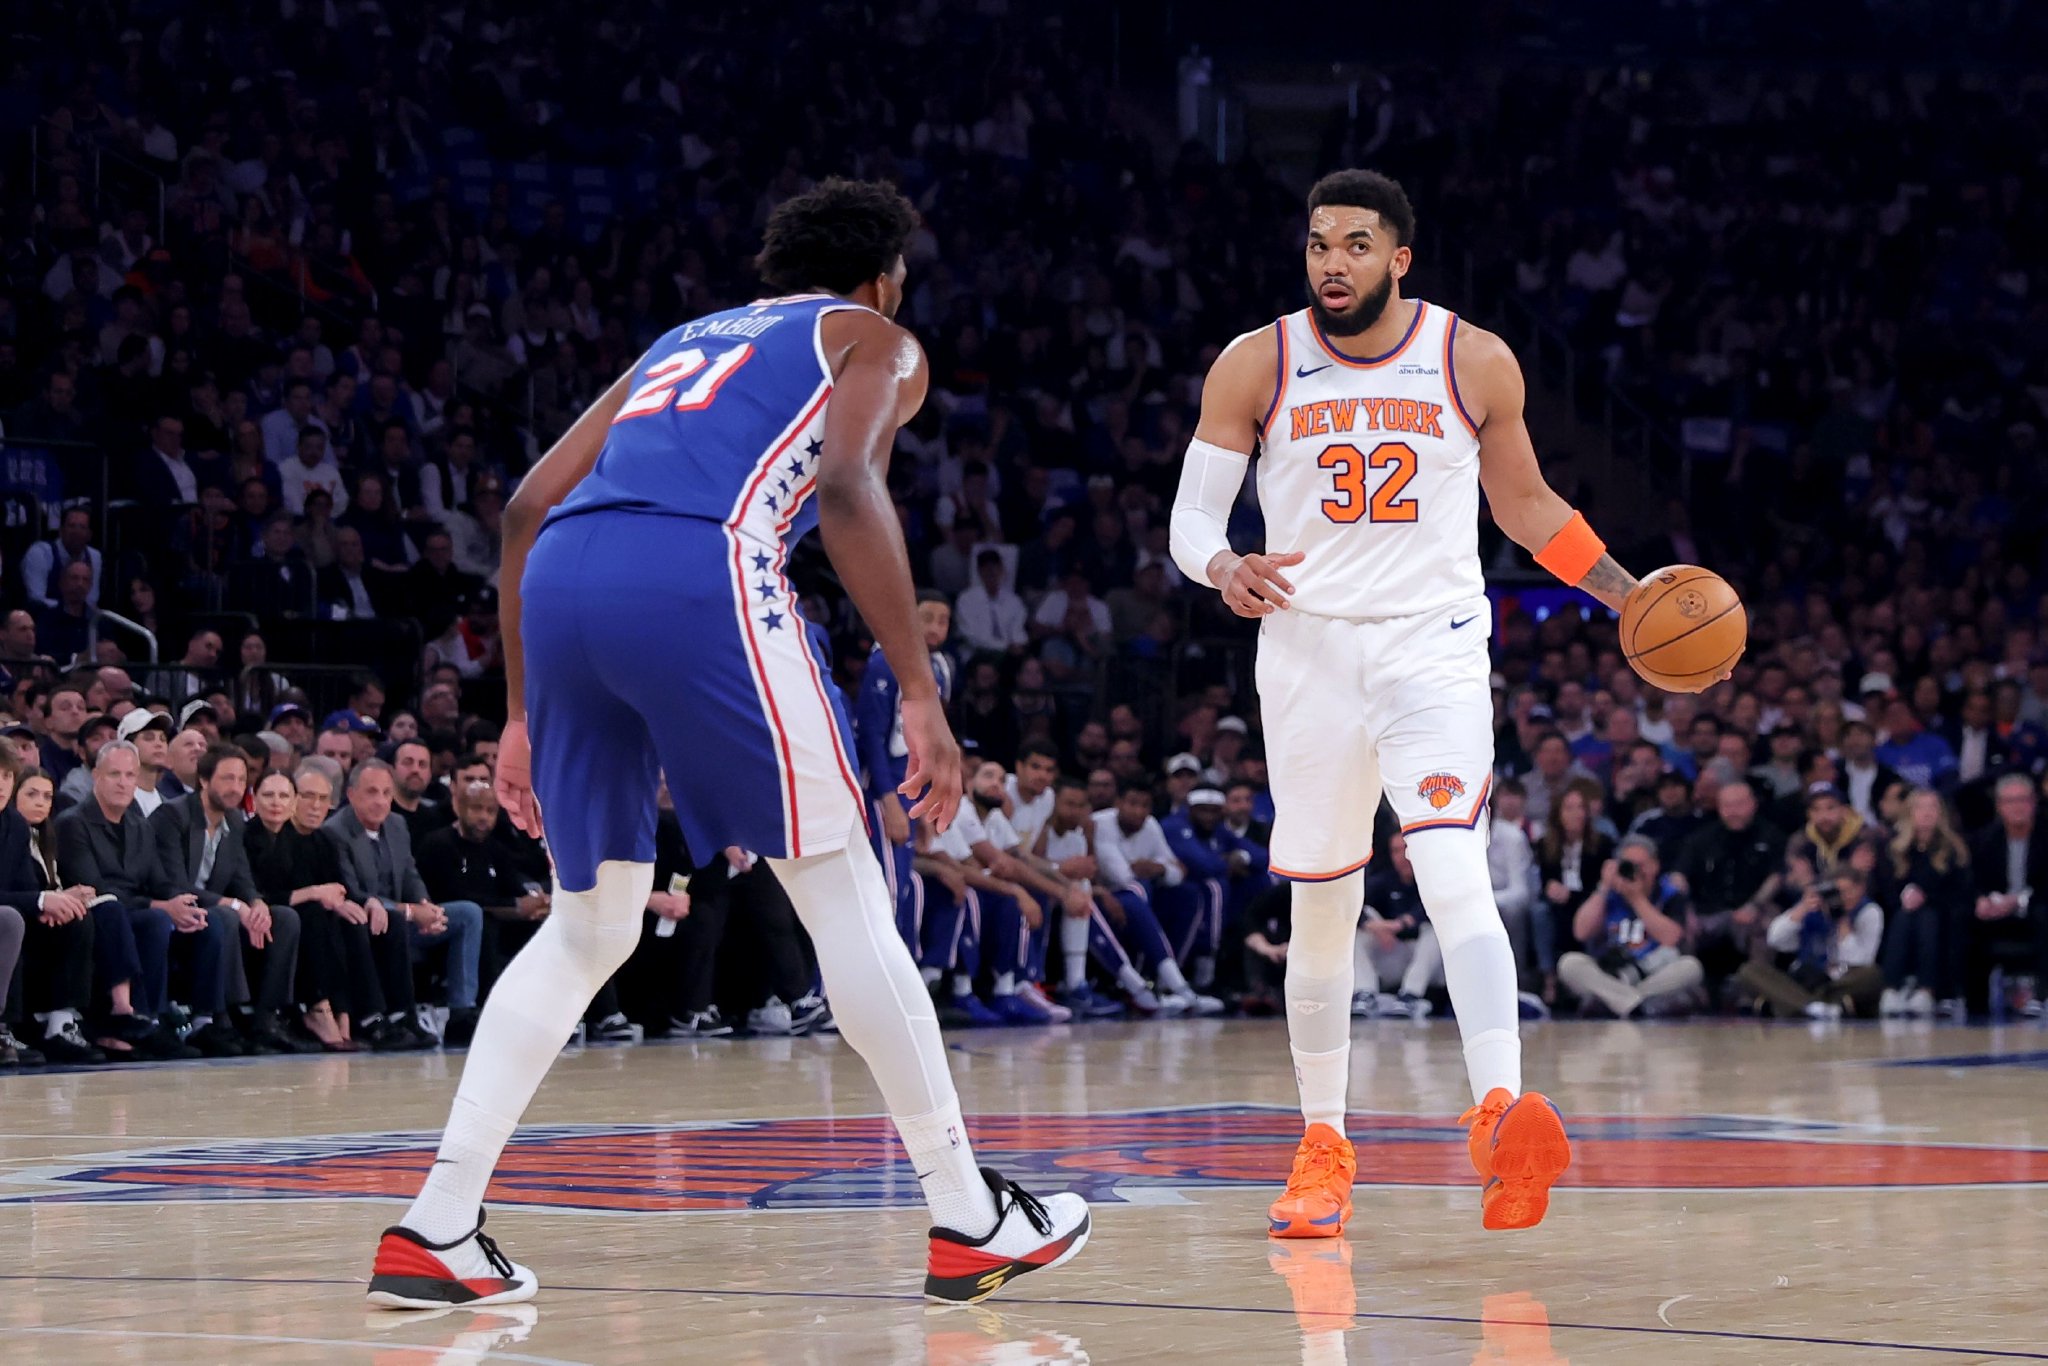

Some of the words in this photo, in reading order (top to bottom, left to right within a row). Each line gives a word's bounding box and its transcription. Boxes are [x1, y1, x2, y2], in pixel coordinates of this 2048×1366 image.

[612, 343, 756, 424] 21
[1398, 367, 1414, 375] abu
[1415, 367, 1439, 376] dhabi
[1290, 398, 1359, 441] NEW
[1363, 398, 1444, 440] YORK
[1317, 442, 1418, 524] 32
[1418, 776, 1466, 795] KNICKS
